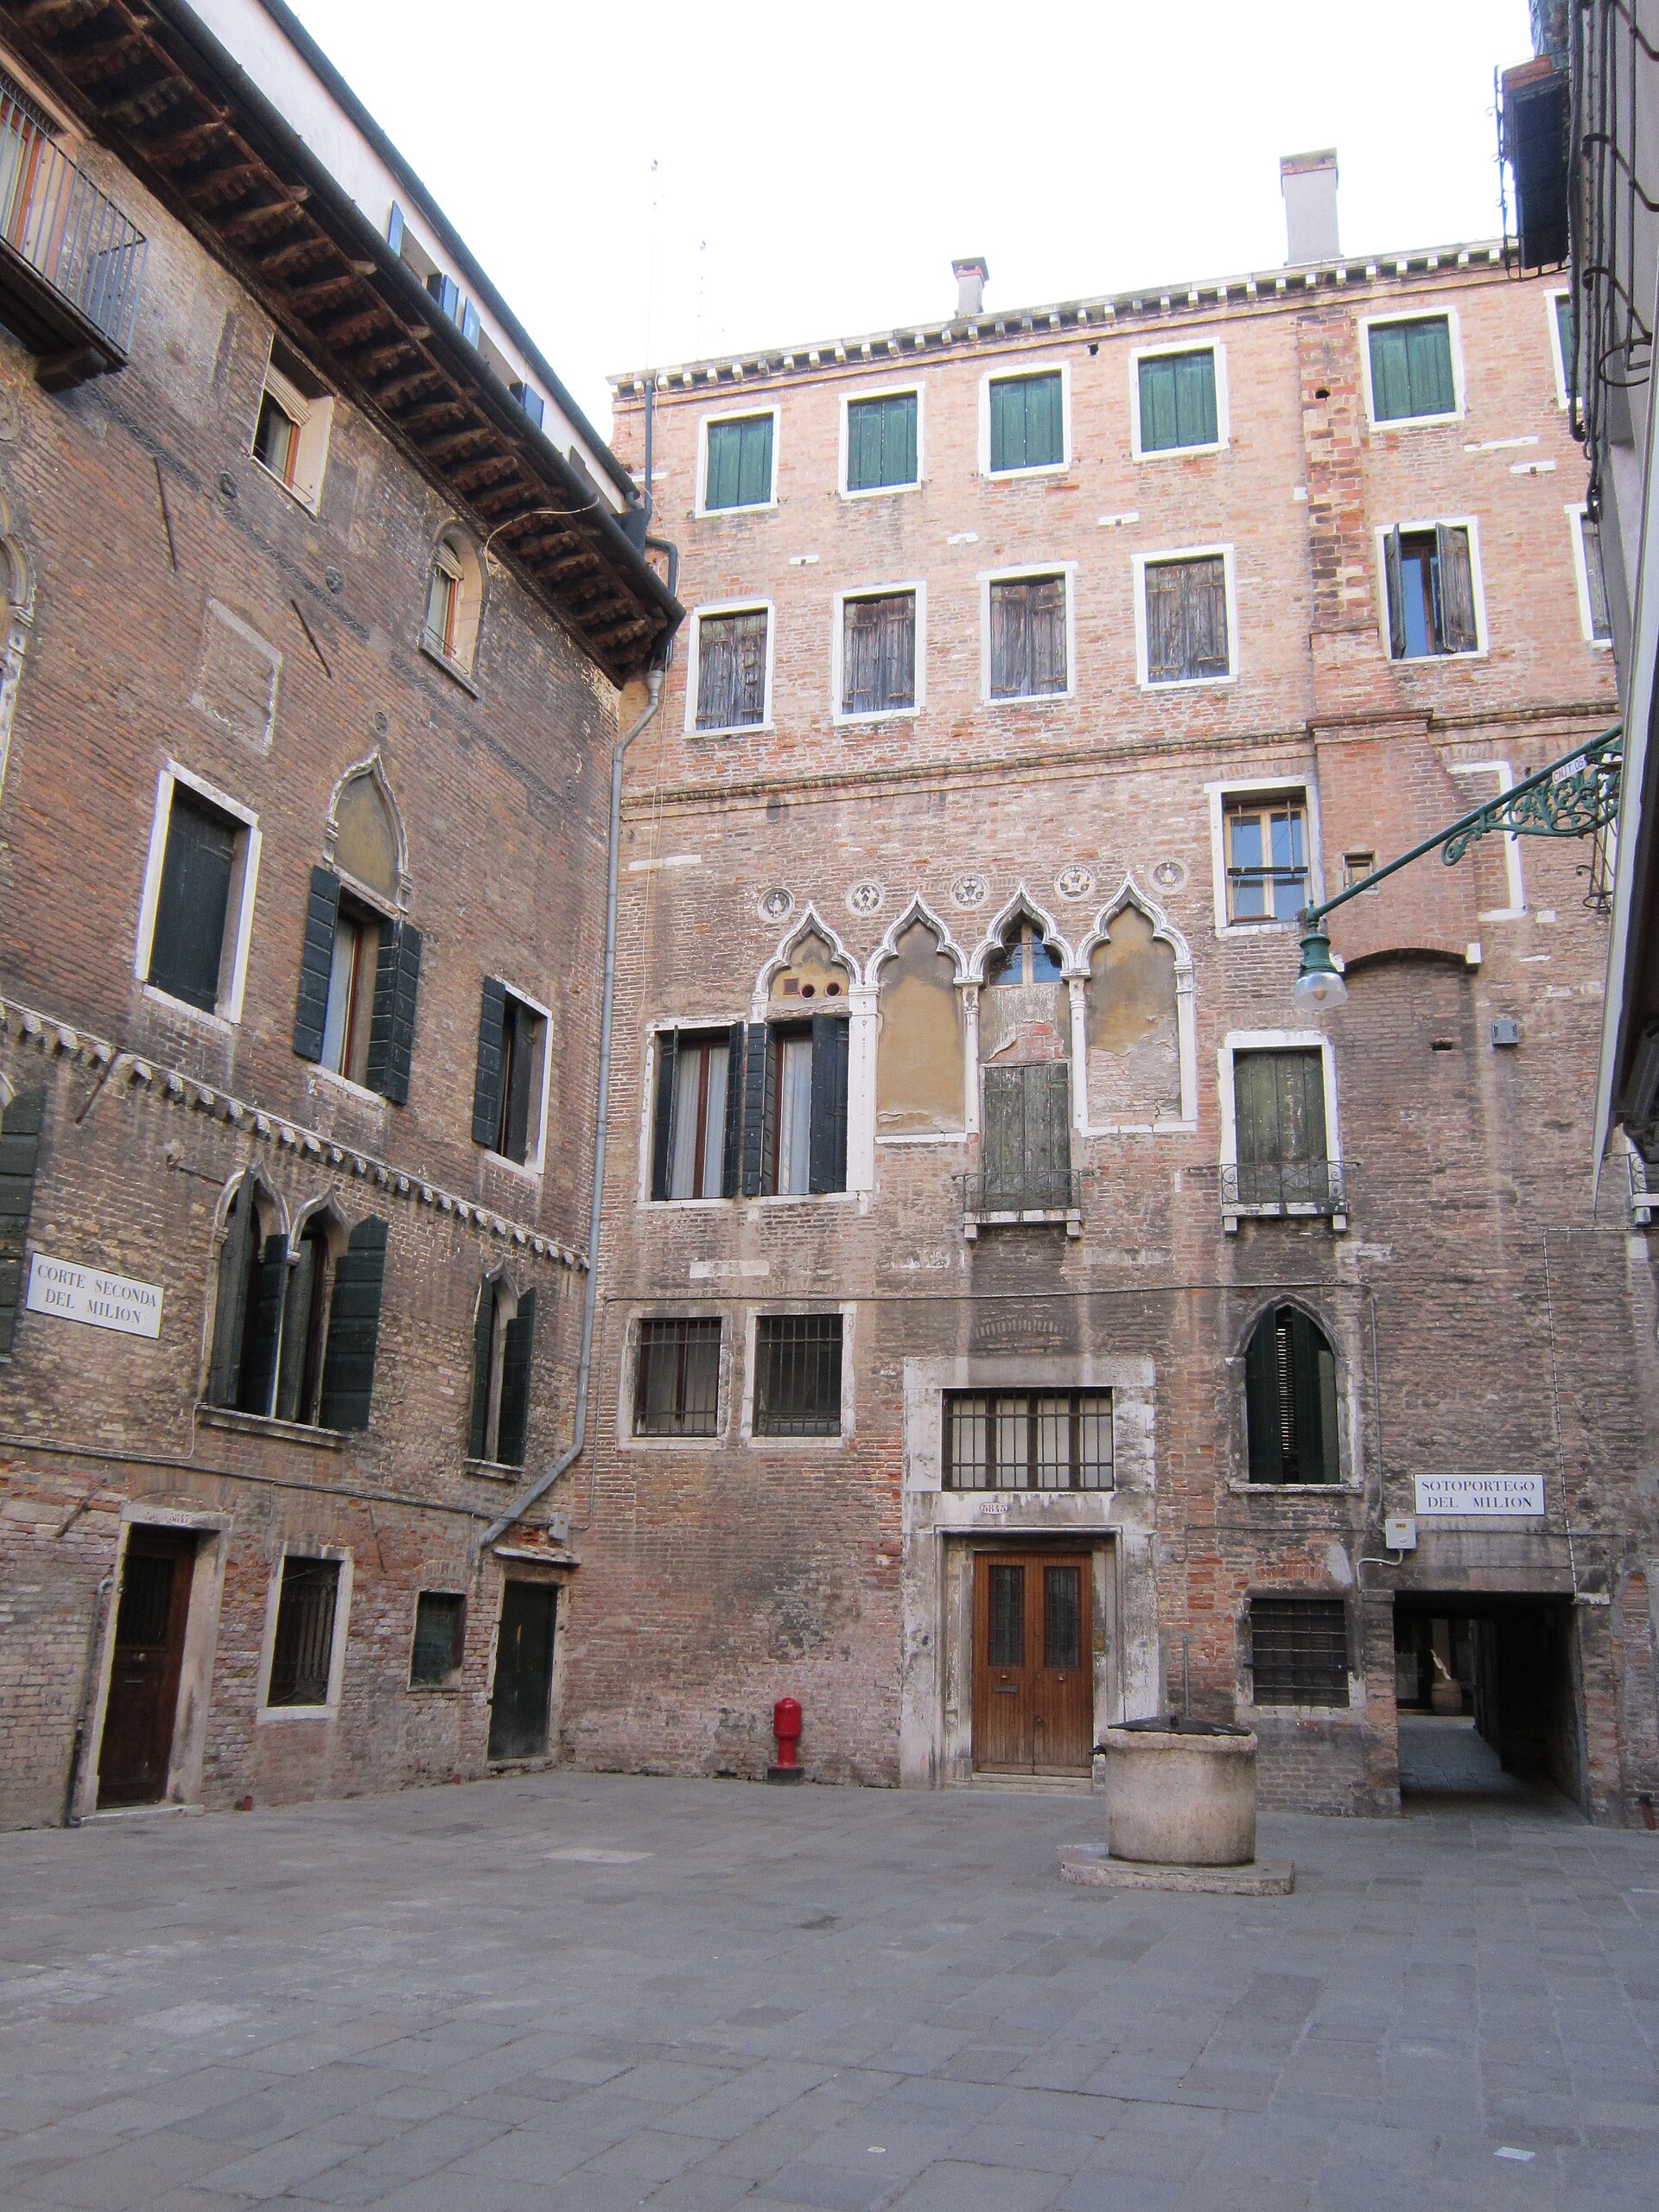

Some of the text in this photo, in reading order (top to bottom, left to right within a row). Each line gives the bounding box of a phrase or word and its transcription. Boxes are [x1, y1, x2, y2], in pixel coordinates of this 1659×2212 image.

[37, 1264, 156, 1308] CORTE SECONDA
[45, 1288, 142, 1325] DEL MILION
[1421, 1480, 1535, 1492] SOTOPORTEGO
[1427, 1497, 1533, 1508] DEL MILION
